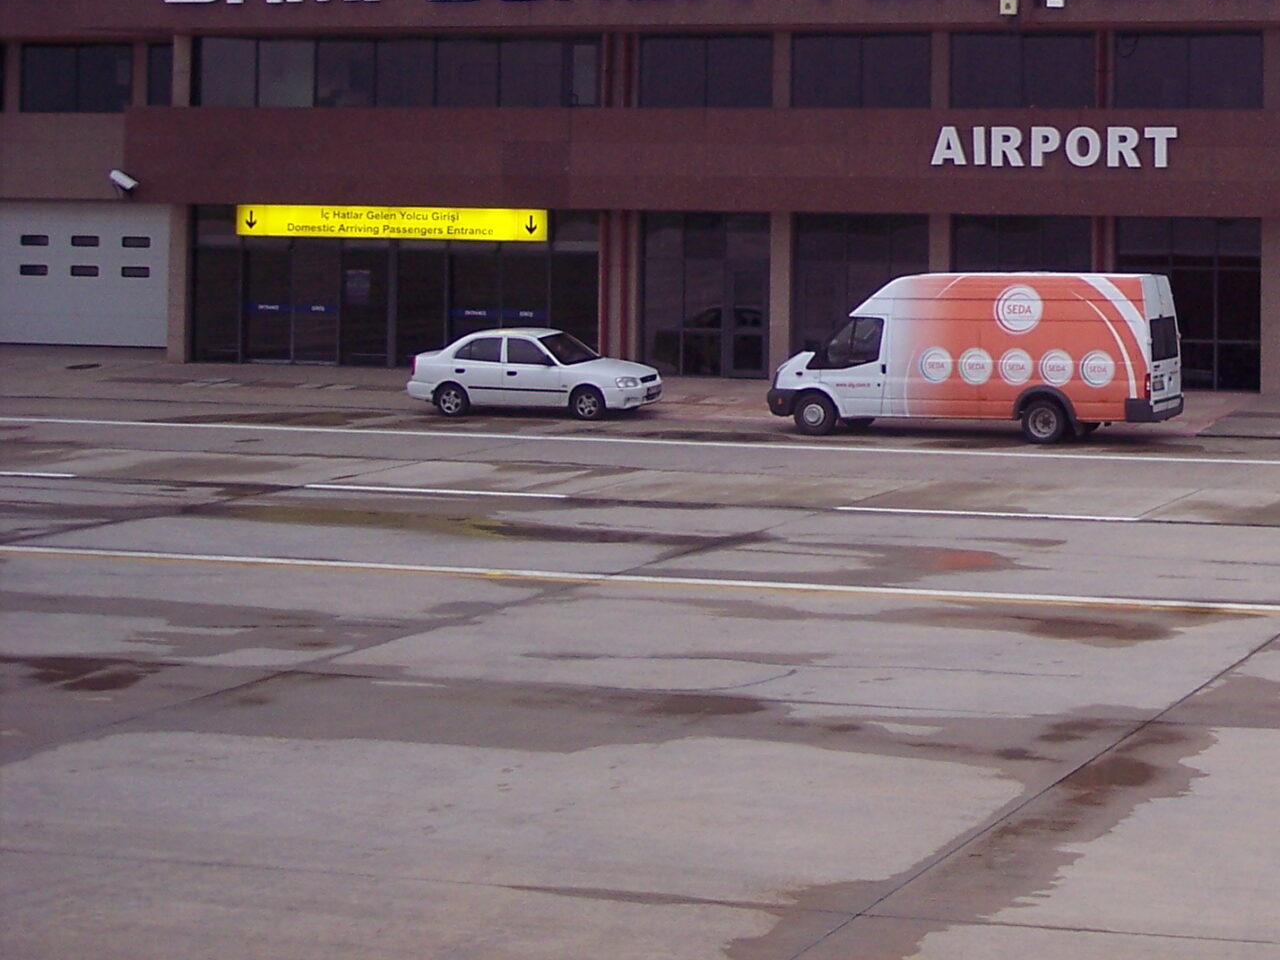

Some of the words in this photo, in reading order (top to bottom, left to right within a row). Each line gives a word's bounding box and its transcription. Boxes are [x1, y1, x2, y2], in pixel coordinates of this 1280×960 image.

[930, 126, 1178, 168] AIRPORT
[333, 210, 363, 220] Hatlar
[366, 210, 397, 220] Gelen
[399, 211, 429, 221] Yolcu
[287, 222, 335, 233] Domestic
[338, 223, 380, 235] Arriving
[382, 224, 444, 236] Passengers
[447, 225, 494, 236] Entrance
[1006, 304, 1032, 315] SEDA
[927, 361, 945, 369] SEDA
[967, 362, 985, 370] SEDA
[1007, 363, 1025, 371] SEDA
[1048, 364, 1066, 372] SEDA
[1088, 365, 1107, 374] SEDA
